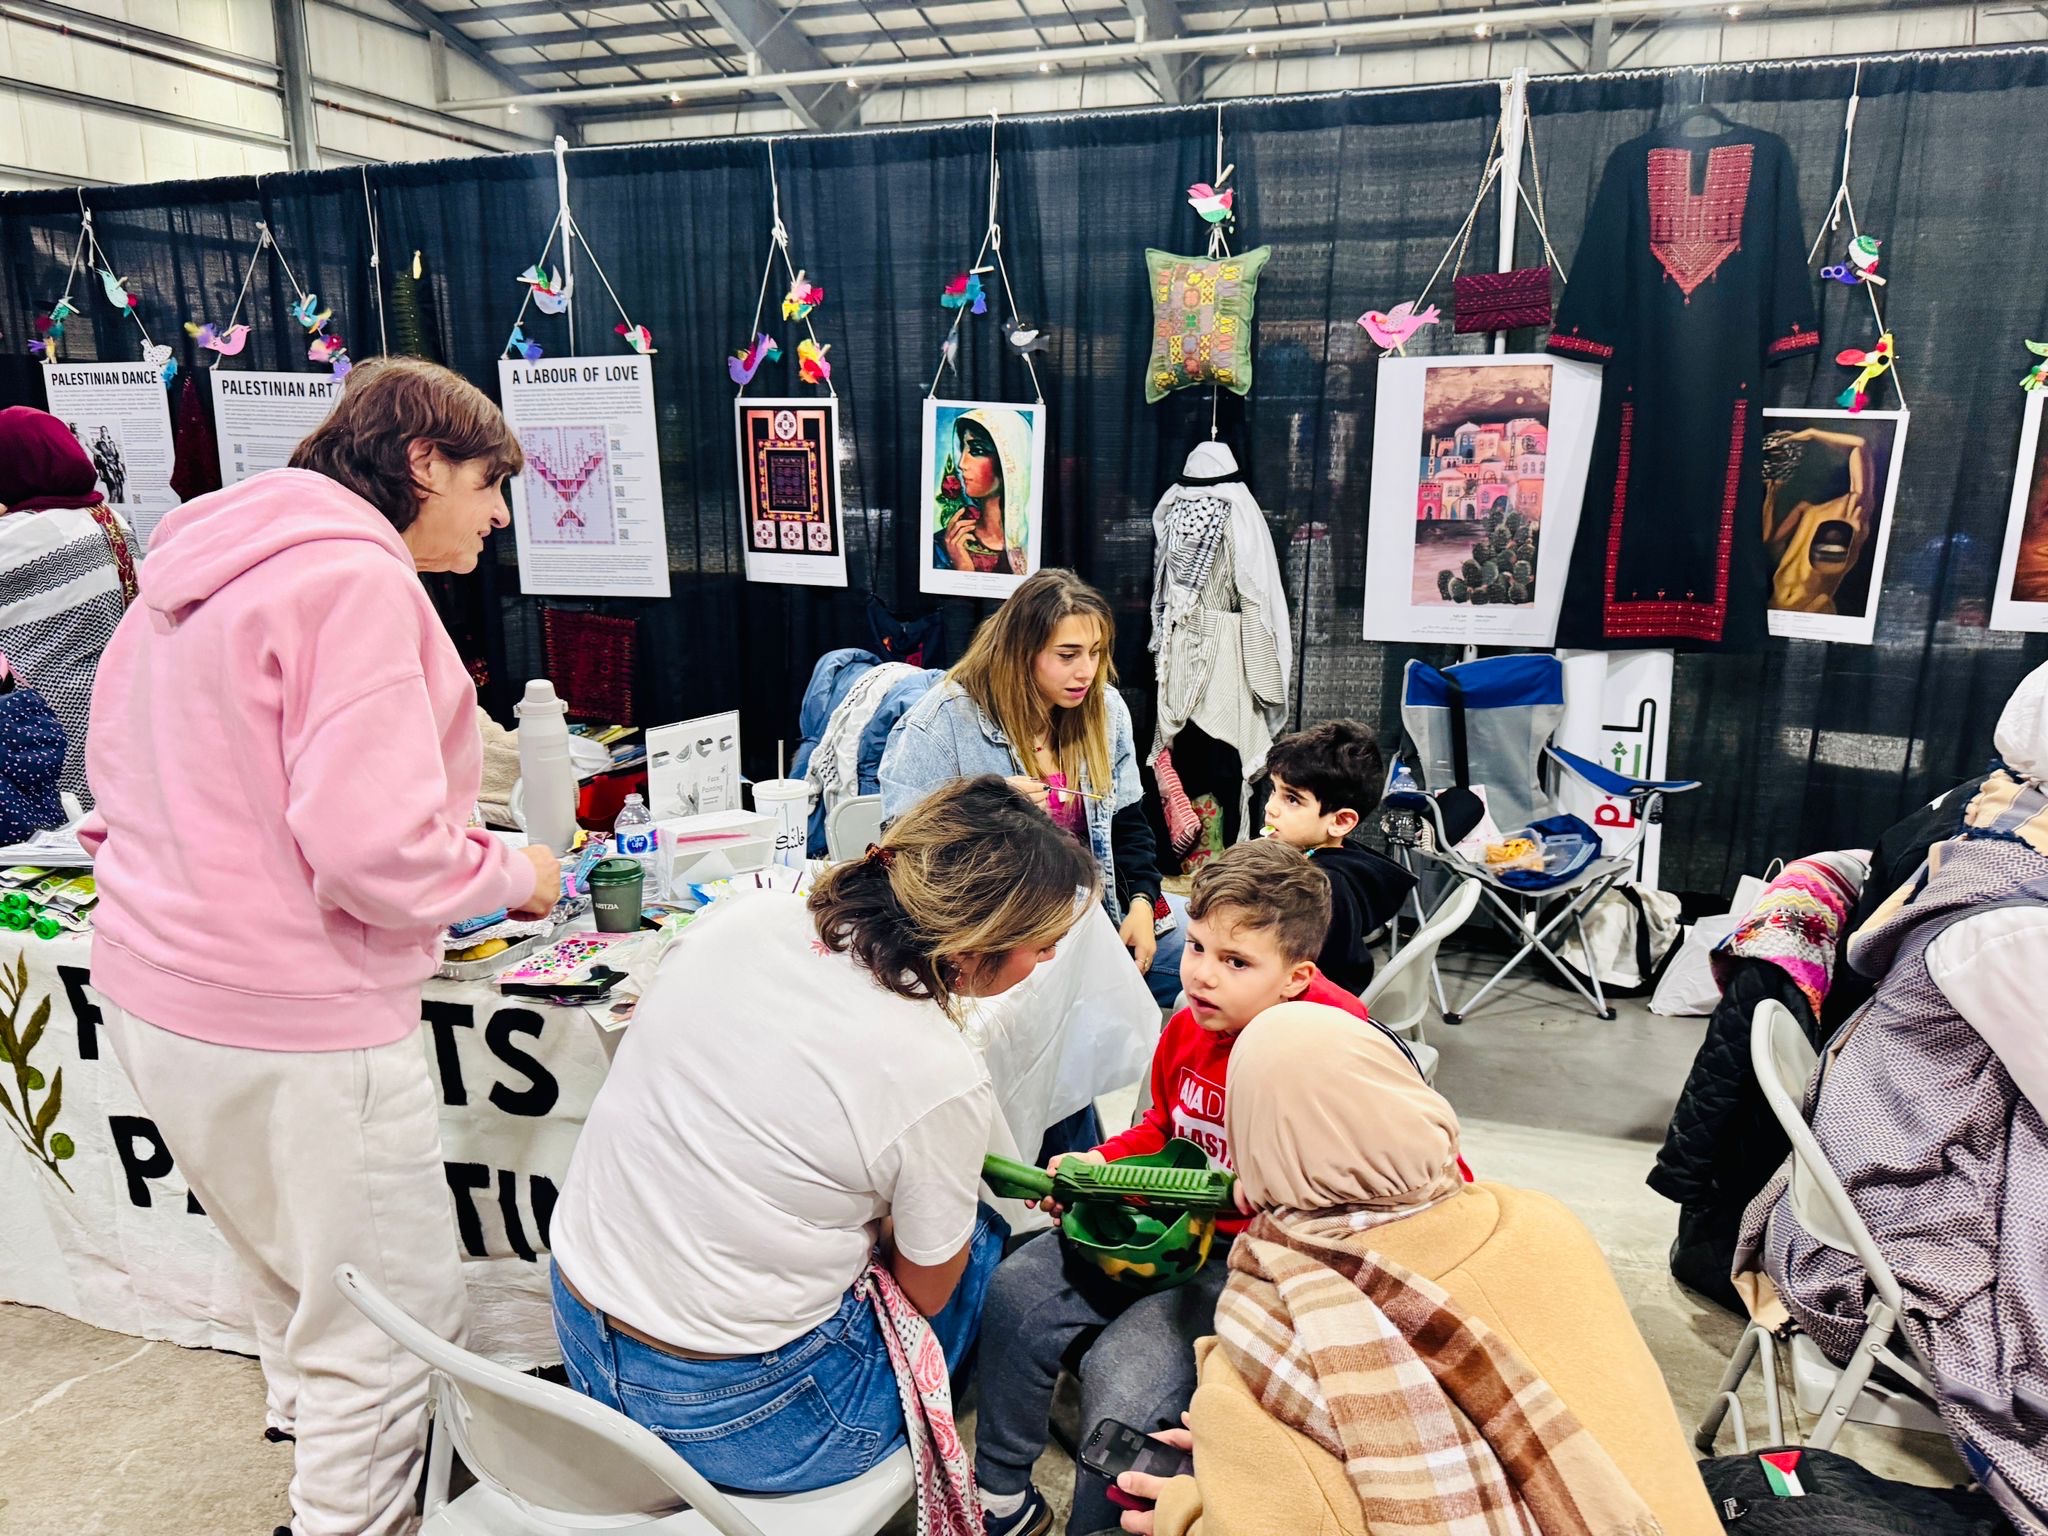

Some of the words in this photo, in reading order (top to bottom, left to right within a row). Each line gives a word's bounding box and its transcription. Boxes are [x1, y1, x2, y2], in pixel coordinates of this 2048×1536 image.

[51, 371, 120, 386] PALESTINIAN
[121, 370, 158, 385] DANCE
[512, 369, 521, 385] A
[525, 368, 578, 384] LABOUR
[583, 367, 599, 382] OF
[605, 365, 639, 382] LOVE
[221, 379, 305, 397] PALESTINIAN
[308, 382, 334, 398] ART
